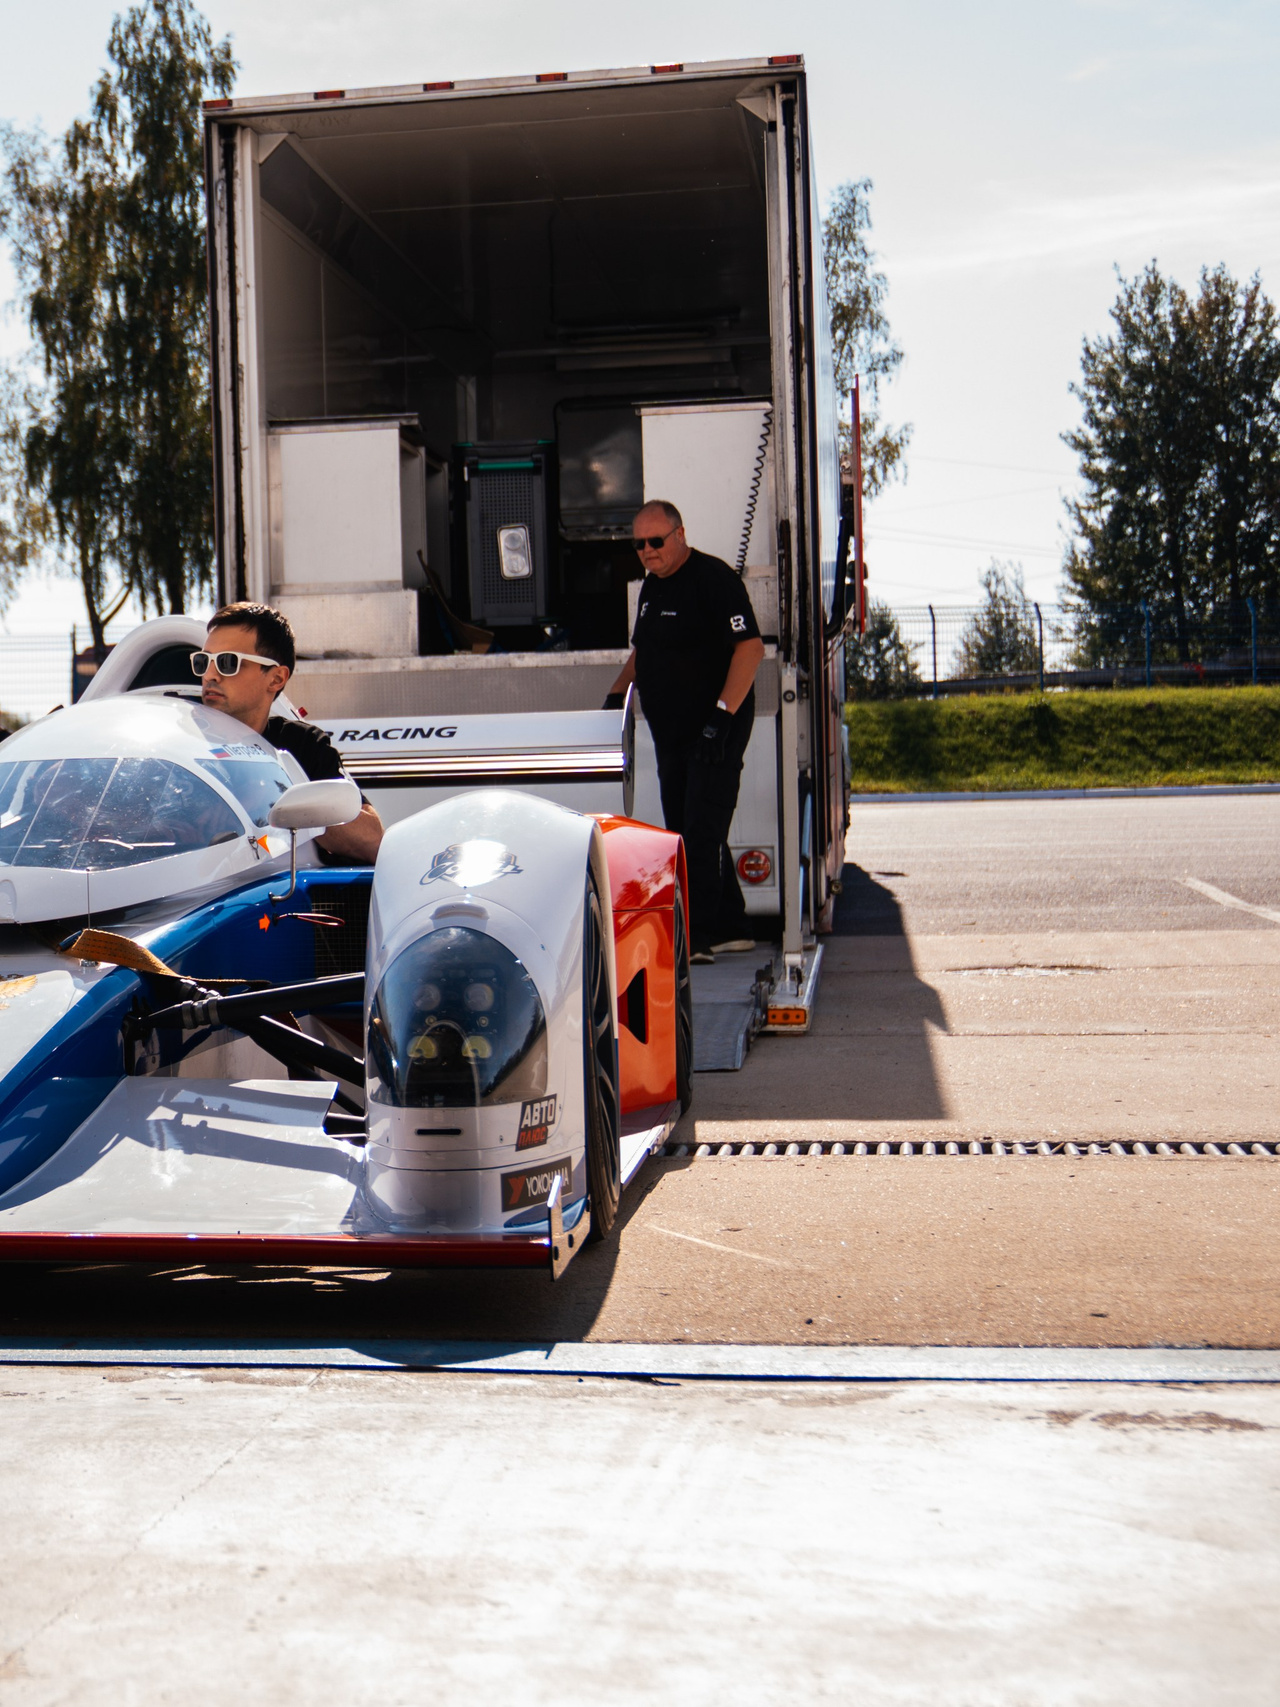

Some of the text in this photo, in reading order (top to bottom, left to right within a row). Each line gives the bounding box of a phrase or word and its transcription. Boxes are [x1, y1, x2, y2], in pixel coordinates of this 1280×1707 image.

[338, 726, 458, 742] RACING
[521, 1098, 556, 1129] АВТО
[518, 1126, 548, 1147] ПЛЮС
[526, 1166, 569, 1197] YOKOHA
